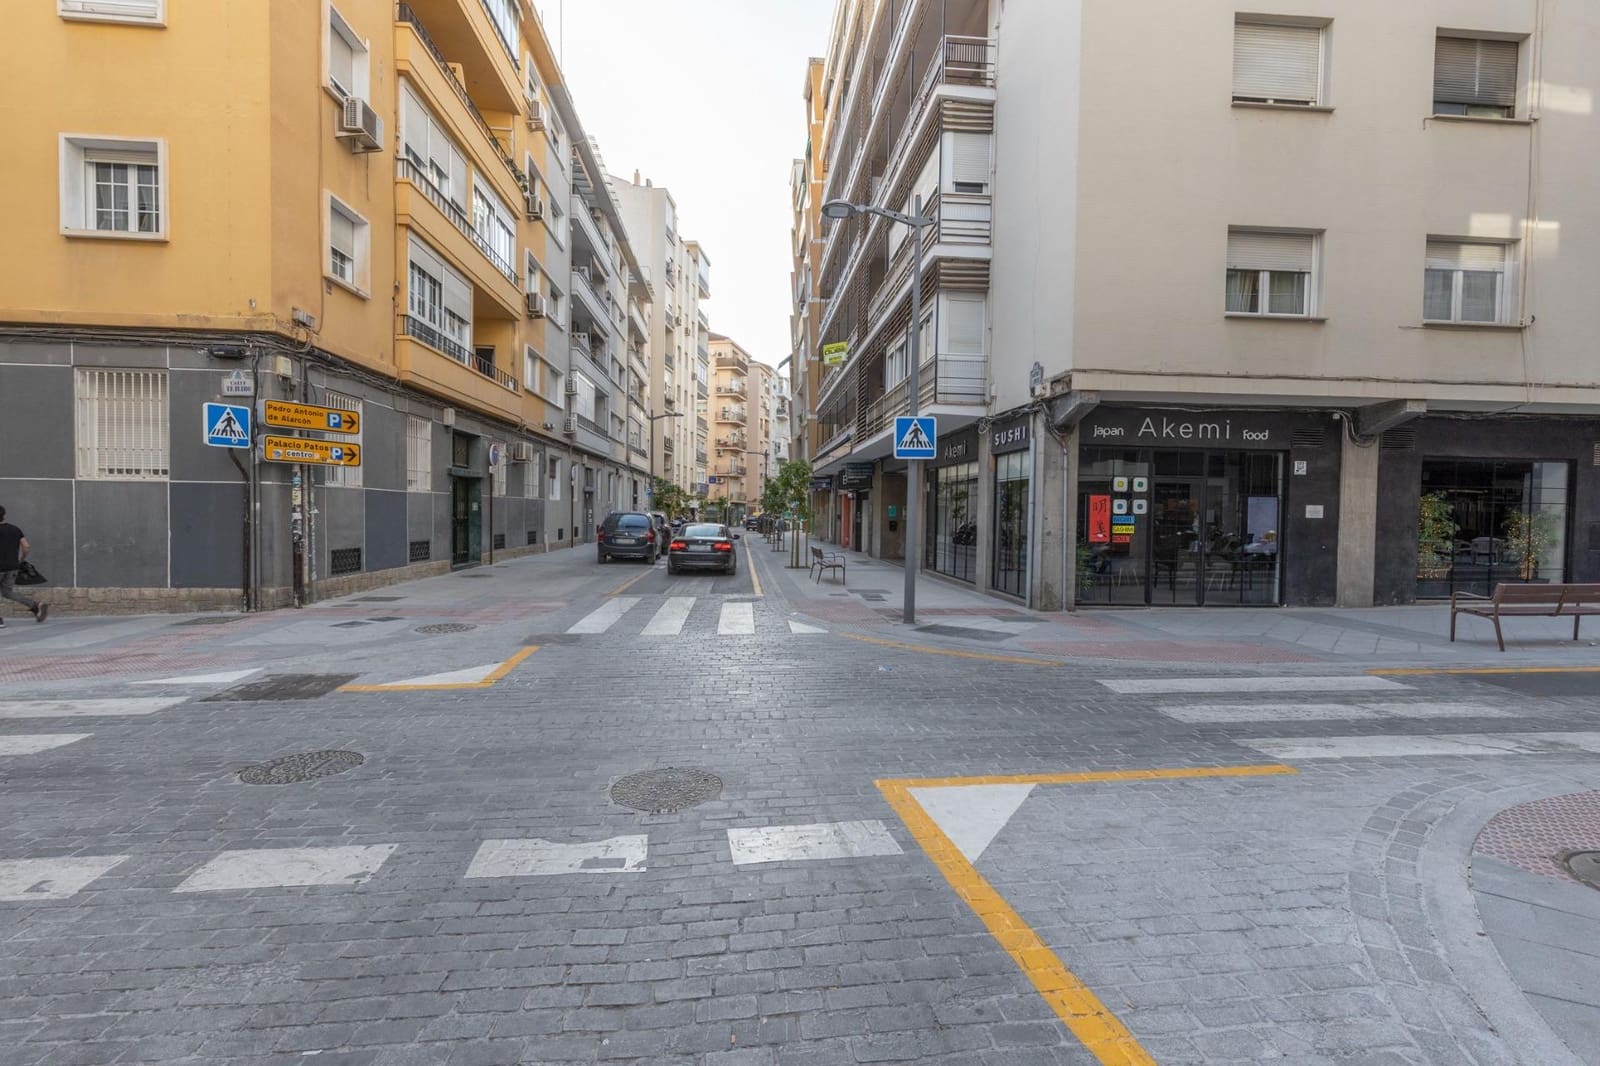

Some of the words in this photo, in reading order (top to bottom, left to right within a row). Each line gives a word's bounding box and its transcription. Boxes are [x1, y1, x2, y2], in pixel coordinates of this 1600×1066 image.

[267, 404, 292, 413] Pedro
[294, 407, 324, 418] Antonio
[267, 413, 279, 421] de
[281, 414, 312, 425] Alarcón
[329, 414, 340, 427] P
[1093, 424, 1124, 438] japan
[1138, 416, 1231, 440] Akemi
[1242, 429, 1269, 440] food
[994, 425, 1026, 446] SUSHI
[267, 438, 302, 450] Palacio
[304, 441, 329, 452] Patos
[944, 439, 967, 460] Akemi
[286, 450, 313, 459] centro
[331, 447, 342, 460] P
